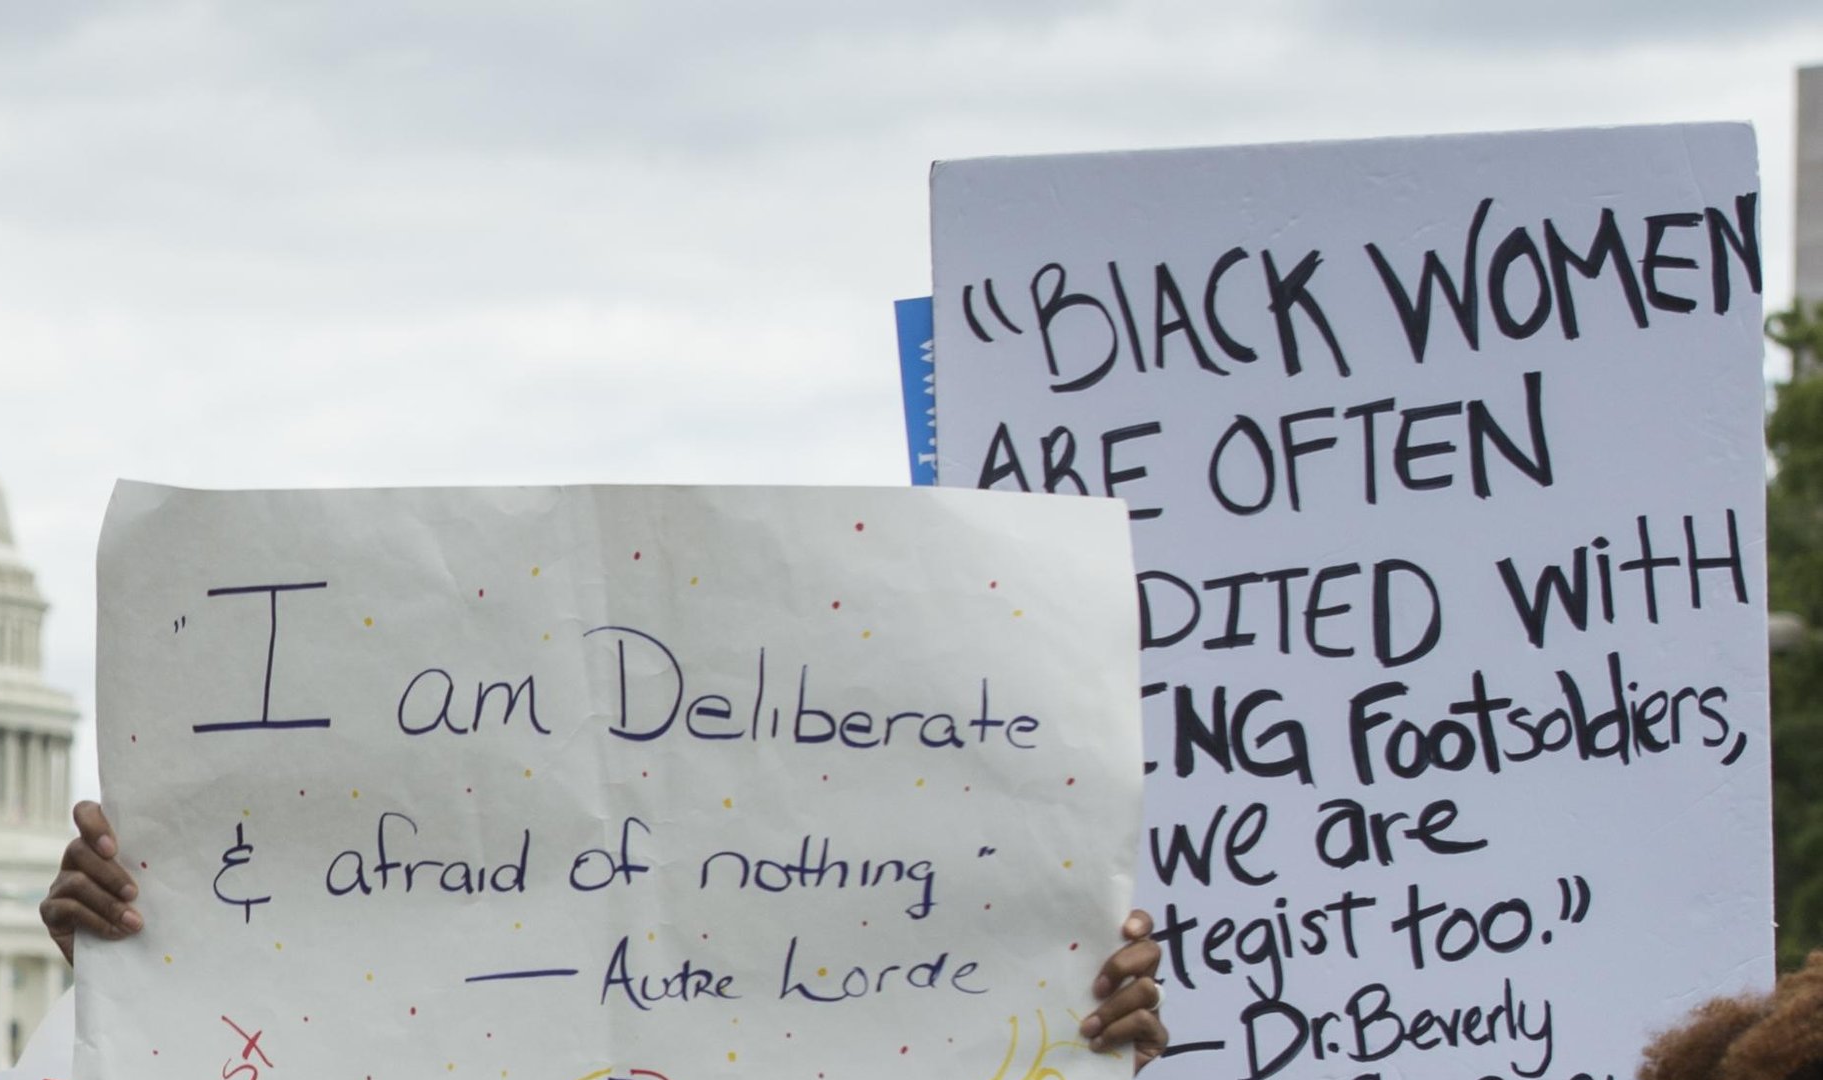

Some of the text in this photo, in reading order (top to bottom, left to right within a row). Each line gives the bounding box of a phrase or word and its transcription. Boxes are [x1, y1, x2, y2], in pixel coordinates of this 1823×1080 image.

[1365, 192, 1763, 363] WOMEN
[1208, 371, 1553, 516] OFTEN
[1139, 557, 1442, 667] DITED
[397, 668, 552, 735] am
[583, 625, 1041, 748] Deliberate
[1350, 653, 1749, 786] Footsoldiers,
[325, 811, 531, 898] afraid
[569, 815, 651, 892] of
[1316, 799, 1488, 869] are
[1153, 891, 1377, 1000] tegist
[1346, 978, 1553, 1078] Beverly
